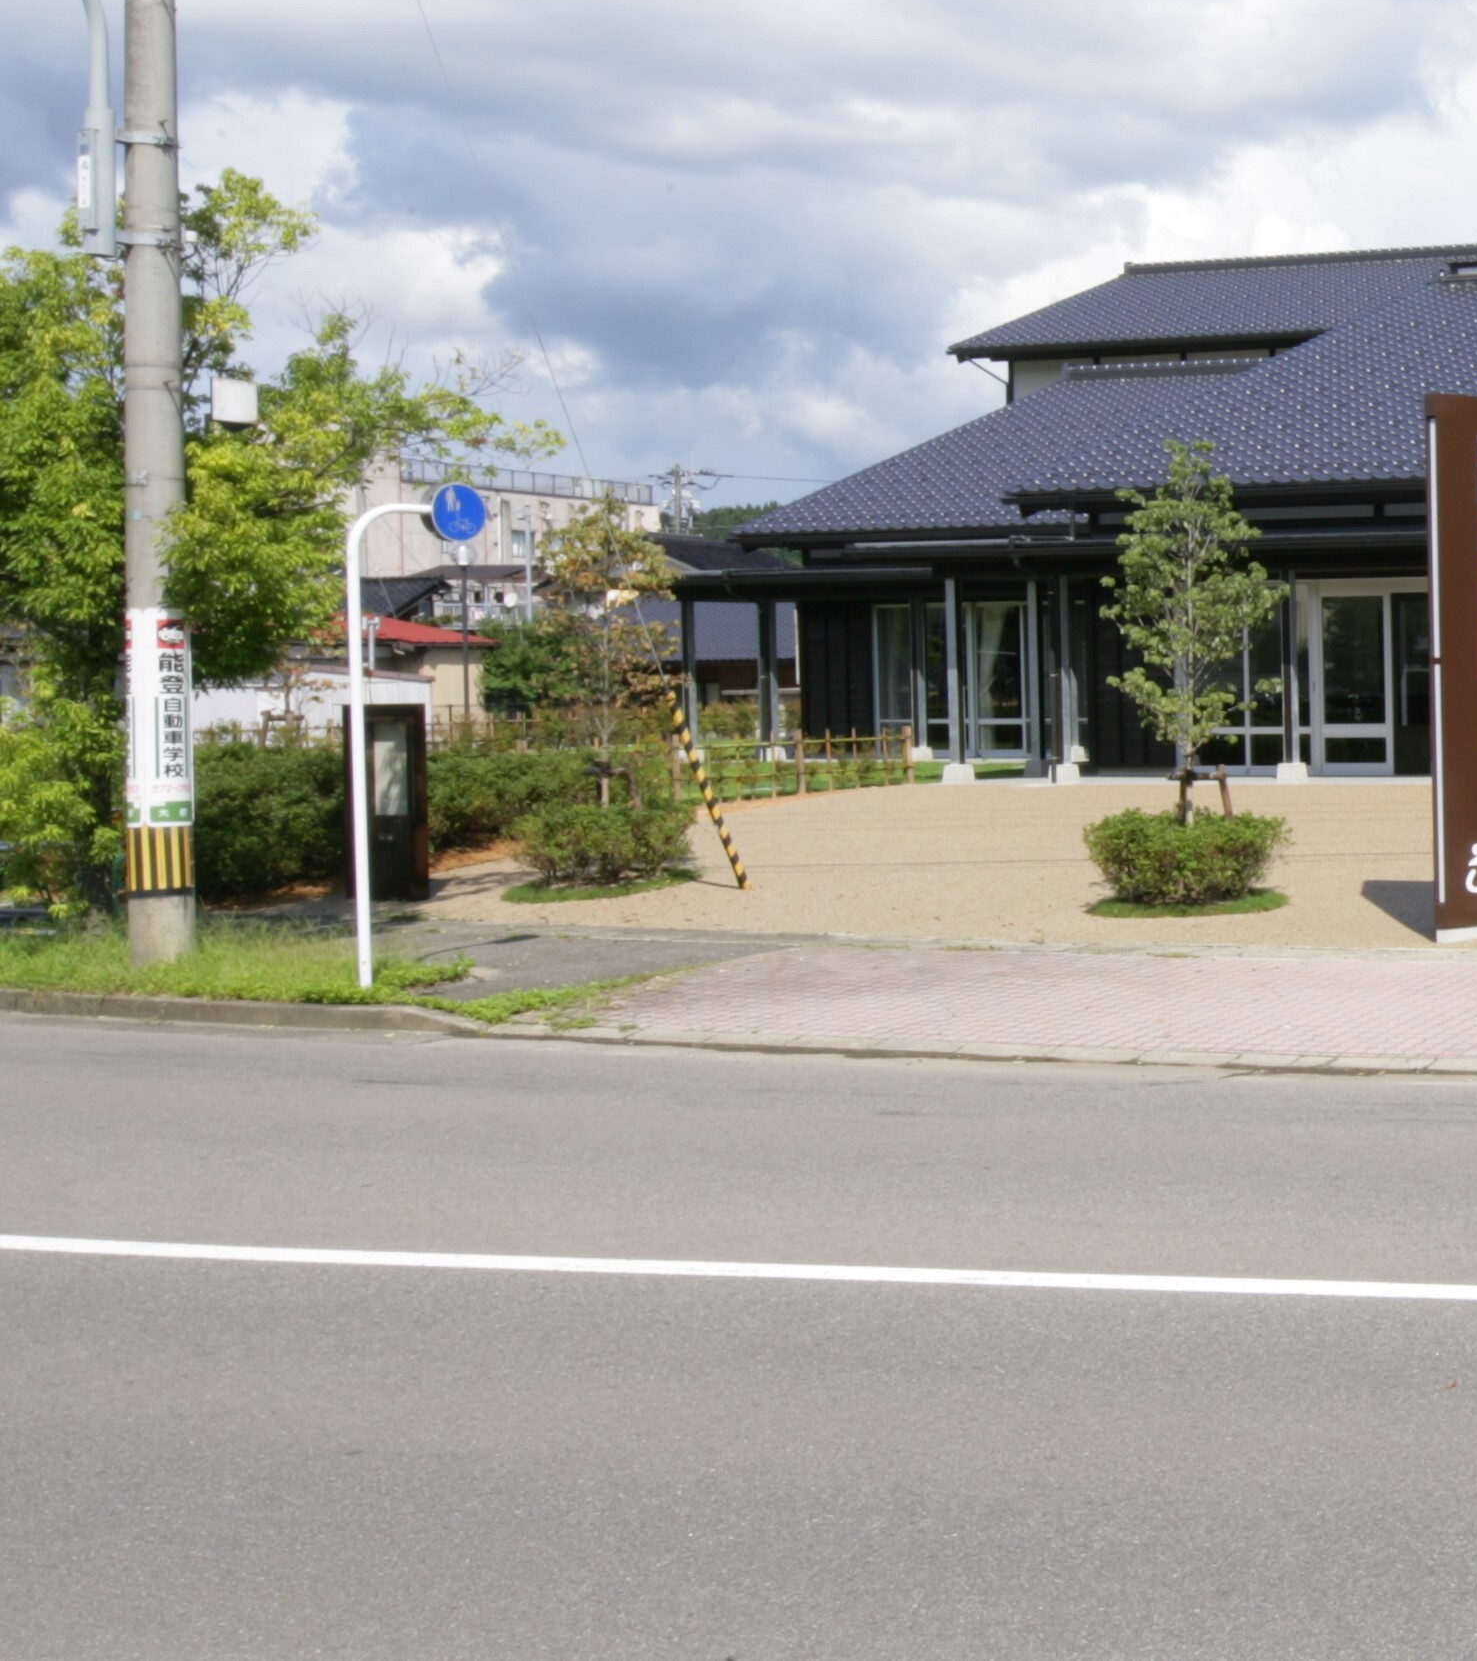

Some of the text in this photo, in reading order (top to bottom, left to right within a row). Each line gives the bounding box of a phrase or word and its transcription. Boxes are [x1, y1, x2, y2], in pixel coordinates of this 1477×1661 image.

[158, 653, 185, 778] 能登自動車学校
